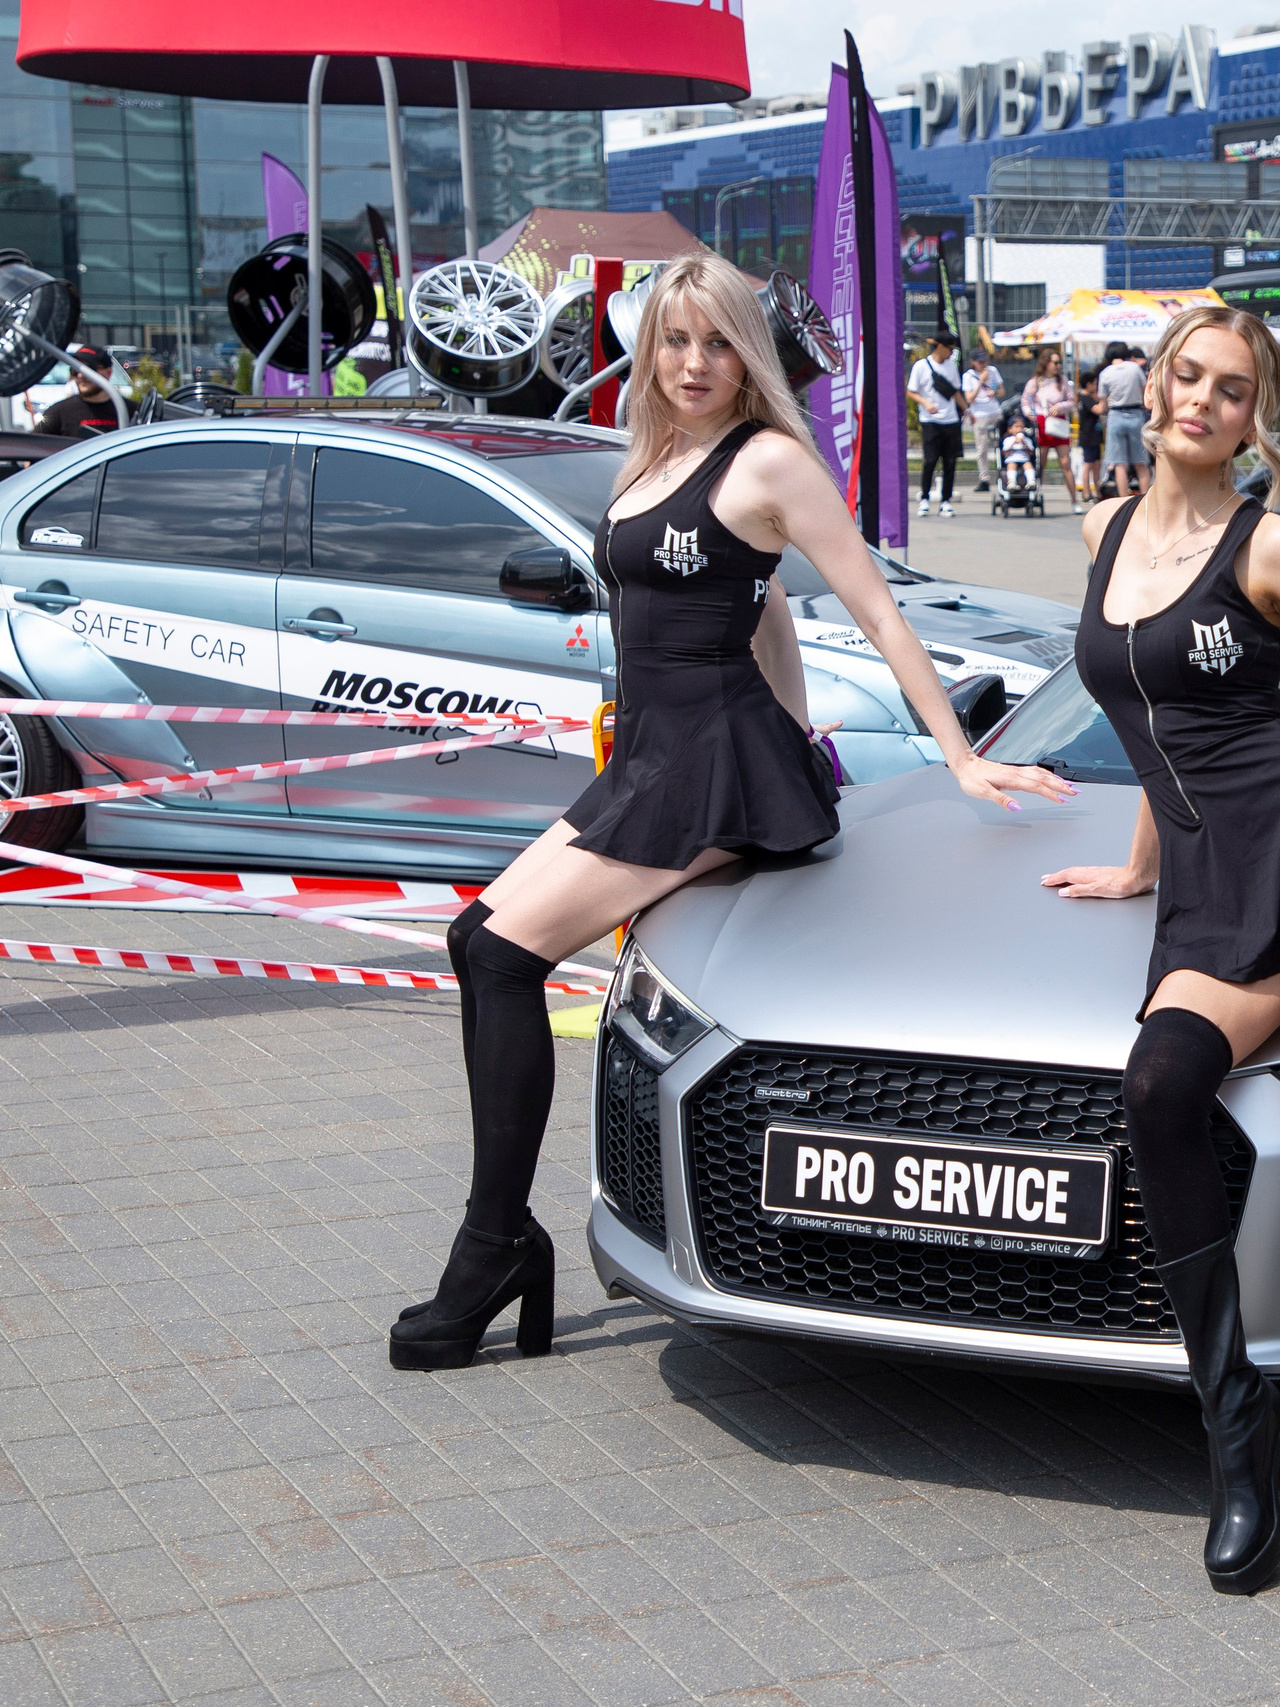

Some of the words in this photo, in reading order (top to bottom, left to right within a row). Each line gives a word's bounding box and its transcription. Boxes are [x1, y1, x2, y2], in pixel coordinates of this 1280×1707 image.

[920, 24, 1213, 147] РИВЬЕРА
[653, 549, 671, 560] PRO
[672, 552, 709, 565] SERVICE
[71, 609, 175, 650] SAFETY
[190, 634, 246, 667] CAR
[1188, 651, 1207, 662] PRO
[1209, 645, 1244, 659] SERVICE
[319, 669, 514, 714] MOSCOW
[756, 1088, 807, 1100] quattro
[795, 1145, 875, 1205] PRO
[892, 1155, 1070, 1225] SERVICE
[891, 1225, 917, 1242] PRO
[918, 1228, 970, 1247] SERVICE
[1004, 1238, 1071, 1255] pro_service
